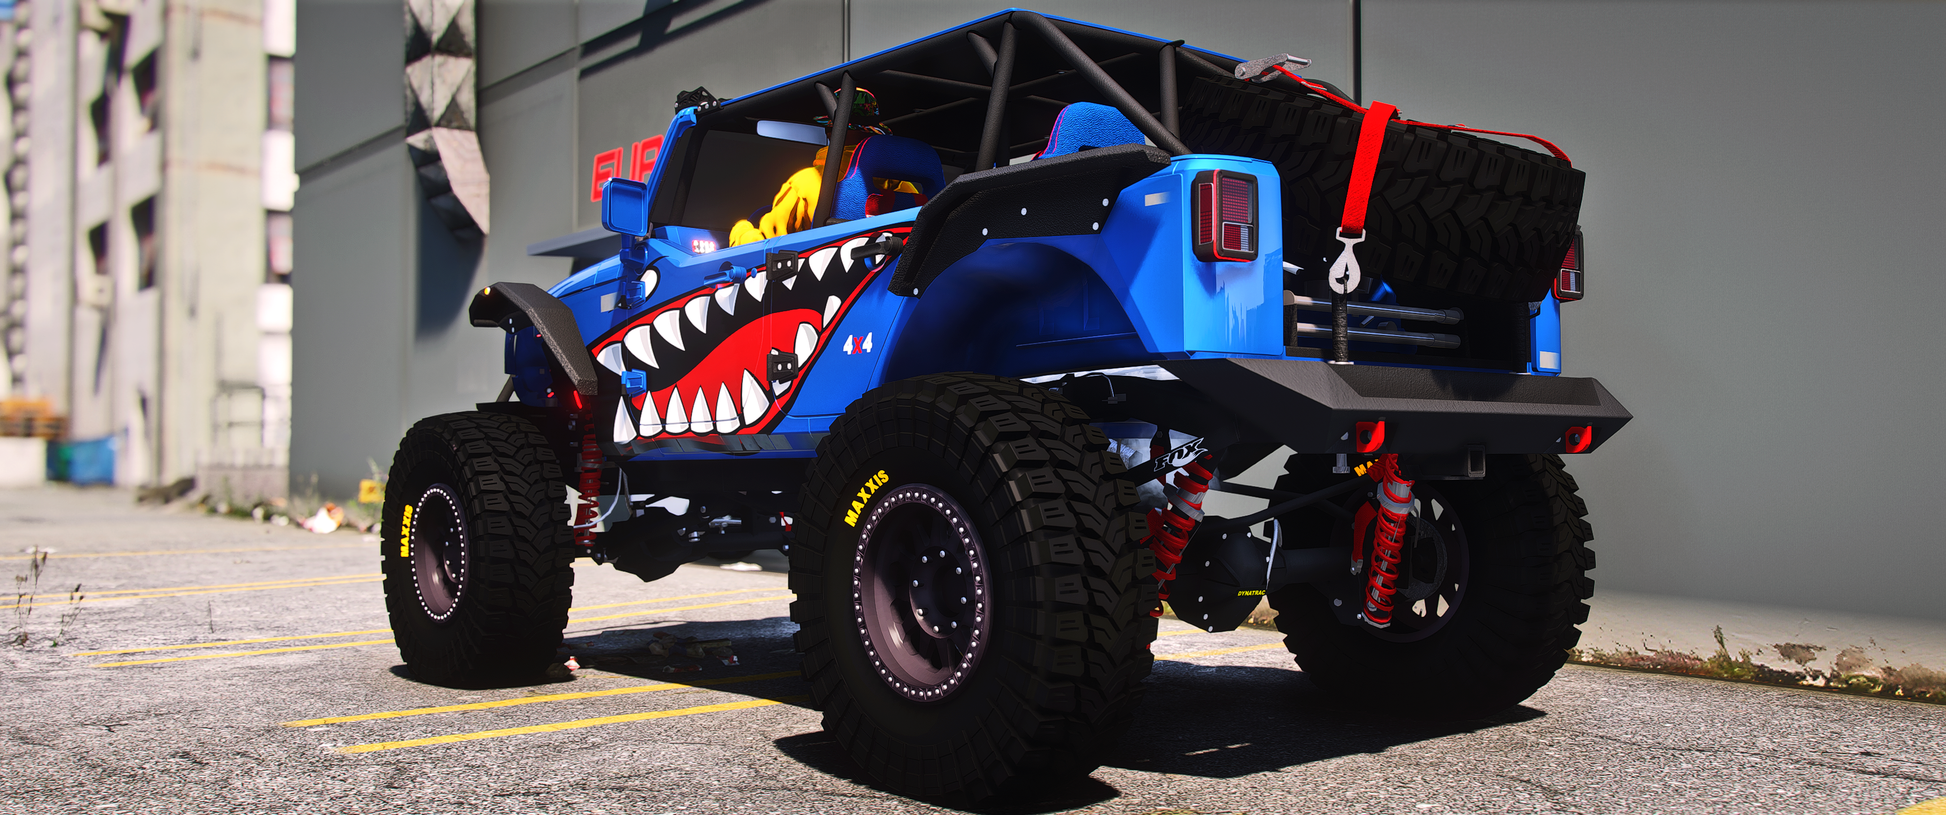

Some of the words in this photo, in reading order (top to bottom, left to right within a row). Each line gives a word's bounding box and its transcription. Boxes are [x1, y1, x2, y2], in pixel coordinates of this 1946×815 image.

[1153, 437, 1208, 472] FOX
[844, 469, 889, 528] MAXXIS
[400, 504, 413, 558] MAXXIS
[1237, 589, 1267, 597] DYNATRAC
